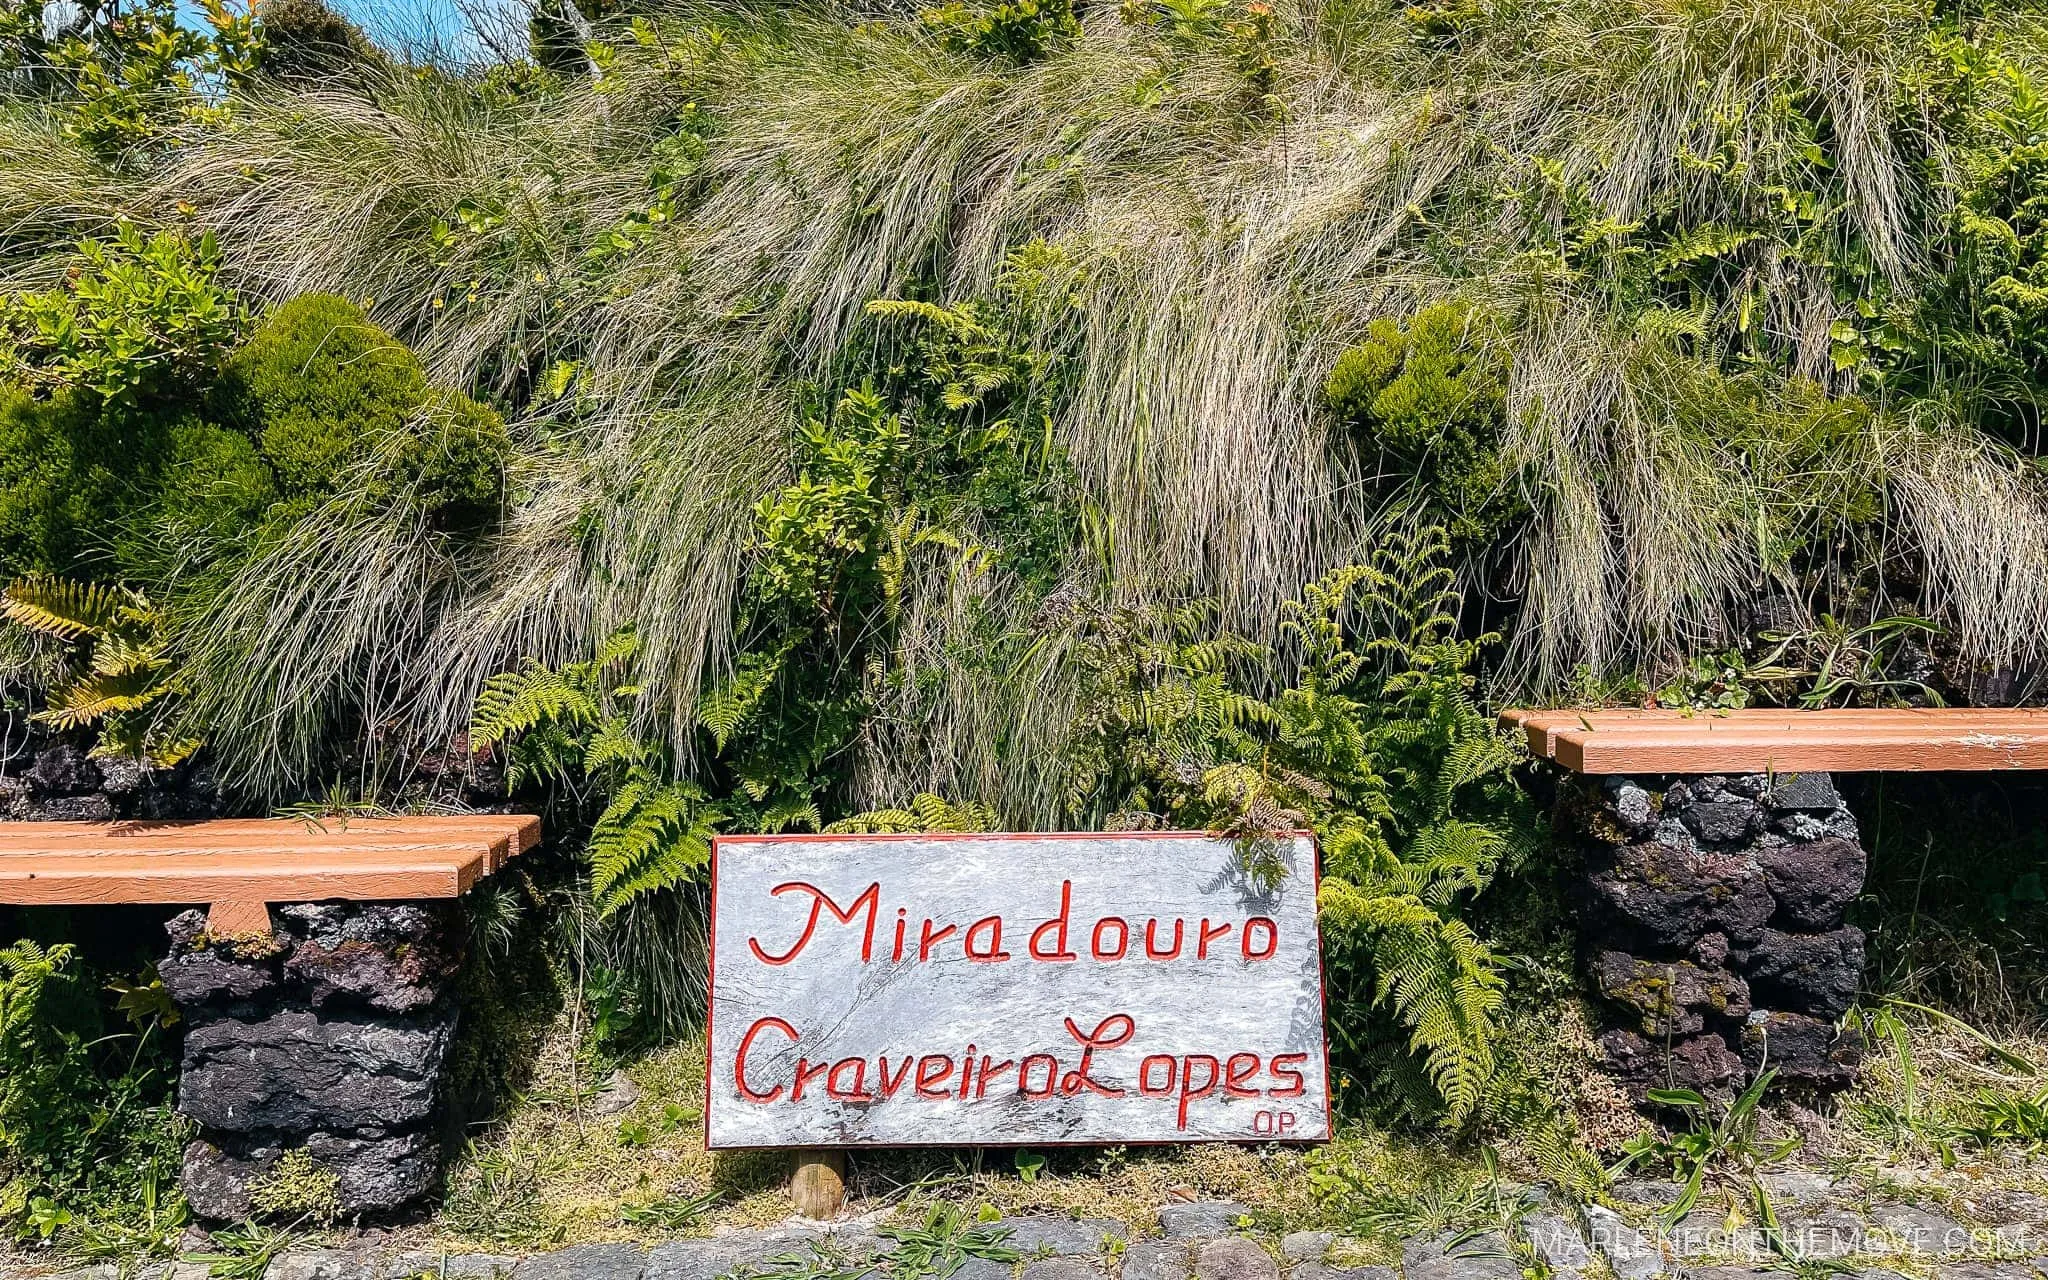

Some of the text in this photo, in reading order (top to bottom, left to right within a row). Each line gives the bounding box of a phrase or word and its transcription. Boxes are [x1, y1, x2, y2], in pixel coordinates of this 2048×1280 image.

[748, 880, 1279, 966] Miradouro
[735, 1015, 1308, 1130] Craveiro Lopes
